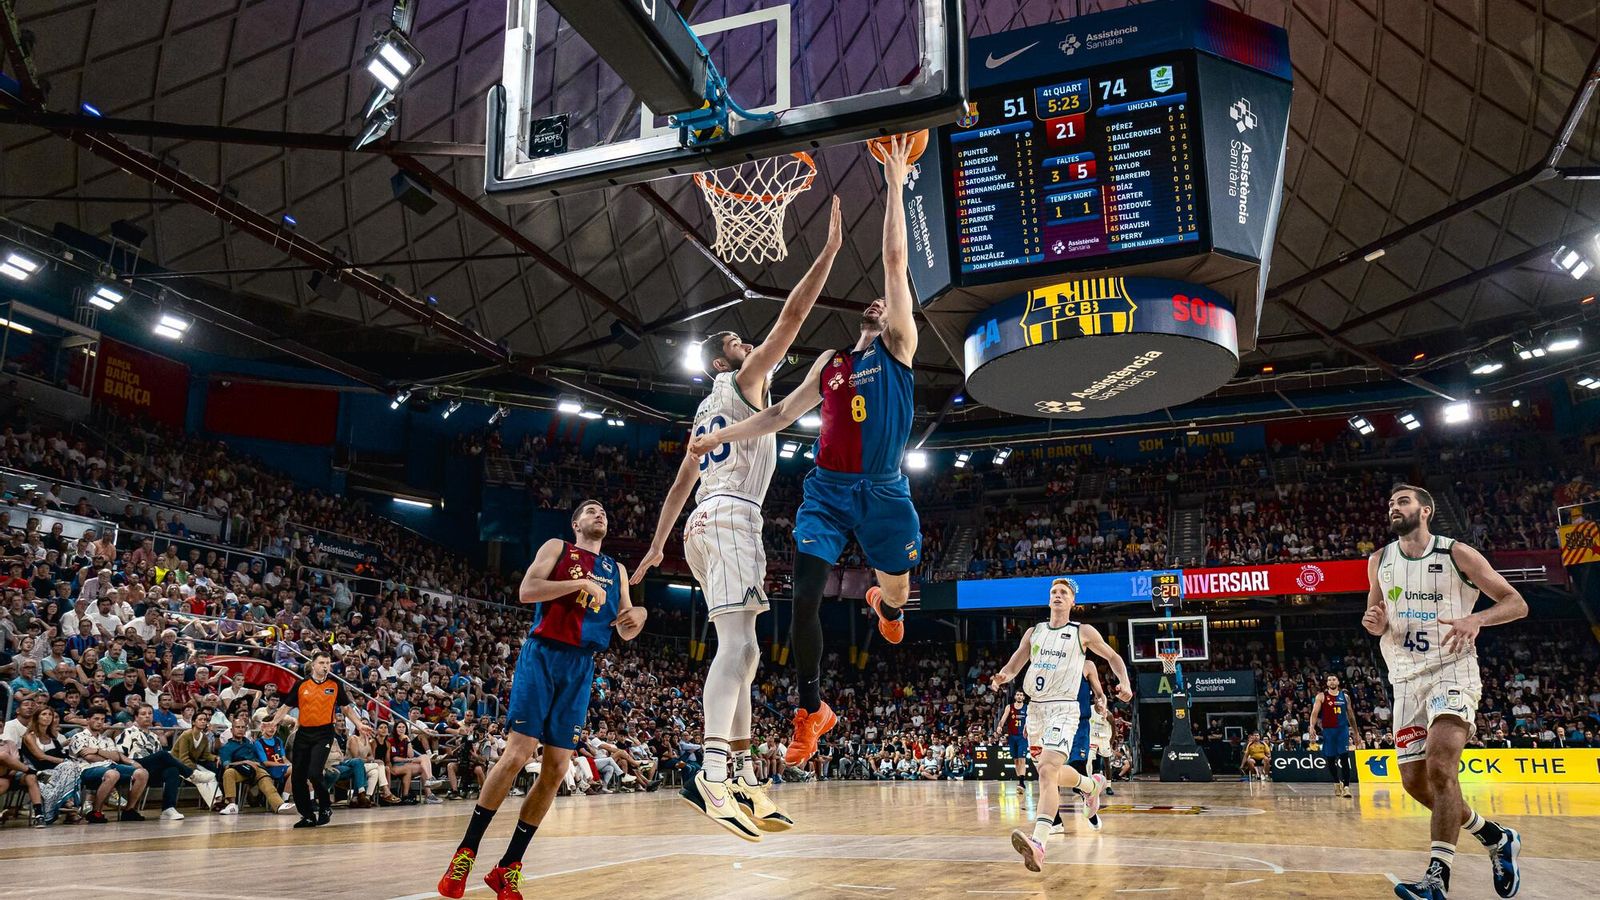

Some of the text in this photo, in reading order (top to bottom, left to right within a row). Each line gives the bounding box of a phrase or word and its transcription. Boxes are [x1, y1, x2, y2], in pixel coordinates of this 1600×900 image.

[1086, 26, 1138, 41] Assistència
[1086, 37, 1123, 49] Sanitària
[1054, 83, 1082, 95] QUART
[1099, 78, 1127, 100] 74
[1004, 97, 1027, 117] 51
[1048, 95, 1079, 112] 5:23
[1128, 101, 1157, 111] UNICAJA
[1056, 122, 1075, 140] 21
[1112, 122, 1133, 132] PÉREZ
[980, 129, 1000, 138] BARÇA
[1112, 128, 1161, 141] BALCEROWSKI
[963, 147, 988, 157] PUNTER
[1113, 143, 1130, 151] EJIM
[964, 155, 998, 166] ANDERSON
[1057, 156, 1079, 165] FALTES
[1114, 150, 1151, 161] KALINOSKI
[965, 165, 996, 176] BRIZUELA
[1114, 162, 1140, 171] TAYLOR
[1229, 139, 1241, 197] Sanitària
[1052, 164, 1087, 182] 3 5
[1116, 170, 1150, 181] BARREIRO
[966, 174, 1006, 186] SATORANSKY
[1239, 142, 1252, 224] Assistència
[966, 182, 1015, 195] HERNANGÓMEZ
[1117, 182, 1133, 191] DÍAZ
[1050, 191, 1092, 203] TEMPS MORT
[1117, 192, 1143, 200] CARTER
[968, 205, 996, 214] ABRINES
[1056, 202, 1090, 218] 1 1
[1118, 200, 1151, 211] DJEDOVIC
[969, 215, 993, 224] PARKER
[1119, 212, 1140, 220] TILLIE
[909, 199, 922, 252] Sanitària
[915, 195, 934, 268] Assistència
[969, 225, 987, 233] KEITA
[1120, 221, 1150, 230] KRAVISH
[970, 234, 991, 243] PARRA
[1068, 237, 1099, 246] Assistència
[1121, 232, 1142, 240] PERRY
[971, 244, 993, 252] VILLAR
[1069, 244, 1090, 252] Sanitària
[1137, 238, 1164, 247] NAVARRO
[972, 252, 1004, 262] GONZÁLEZ
[987, 258, 1019, 268] PEÑARROYA
[106, 366, 139, 386] BARÇA
[1071, 351, 1163, 399] Assistència
[1089, 370, 1157, 401] Sanitària
[104, 378, 150, 406] BARÇA
[851, 395, 867, 422] 8
[1138, 439, 1164, 452] SOM
[319, 542, 354, 557] Assistència
[1131, 575, 1152, 597] 12
[1183, 570, 1269, 594] NIVERSARI
[1163, 586, 1178, 597] 20
[1405, 591, 1443, 603] Unicaja
[1398, 608, 1436, 621] málaga
[1403, 631, 1429, 652] 45
[1041, 649, 1066, 659] Unicaja
[1036, 676, 1045, 691] 9
[1158, 676, 1172, 694] A
[1196, 684, 1224, 692] Sanitària
[998, 751, 1012, 759] 5:2
[1275, 754, 1352, 769] endea
[1514, 758, 1566, 774] THE
